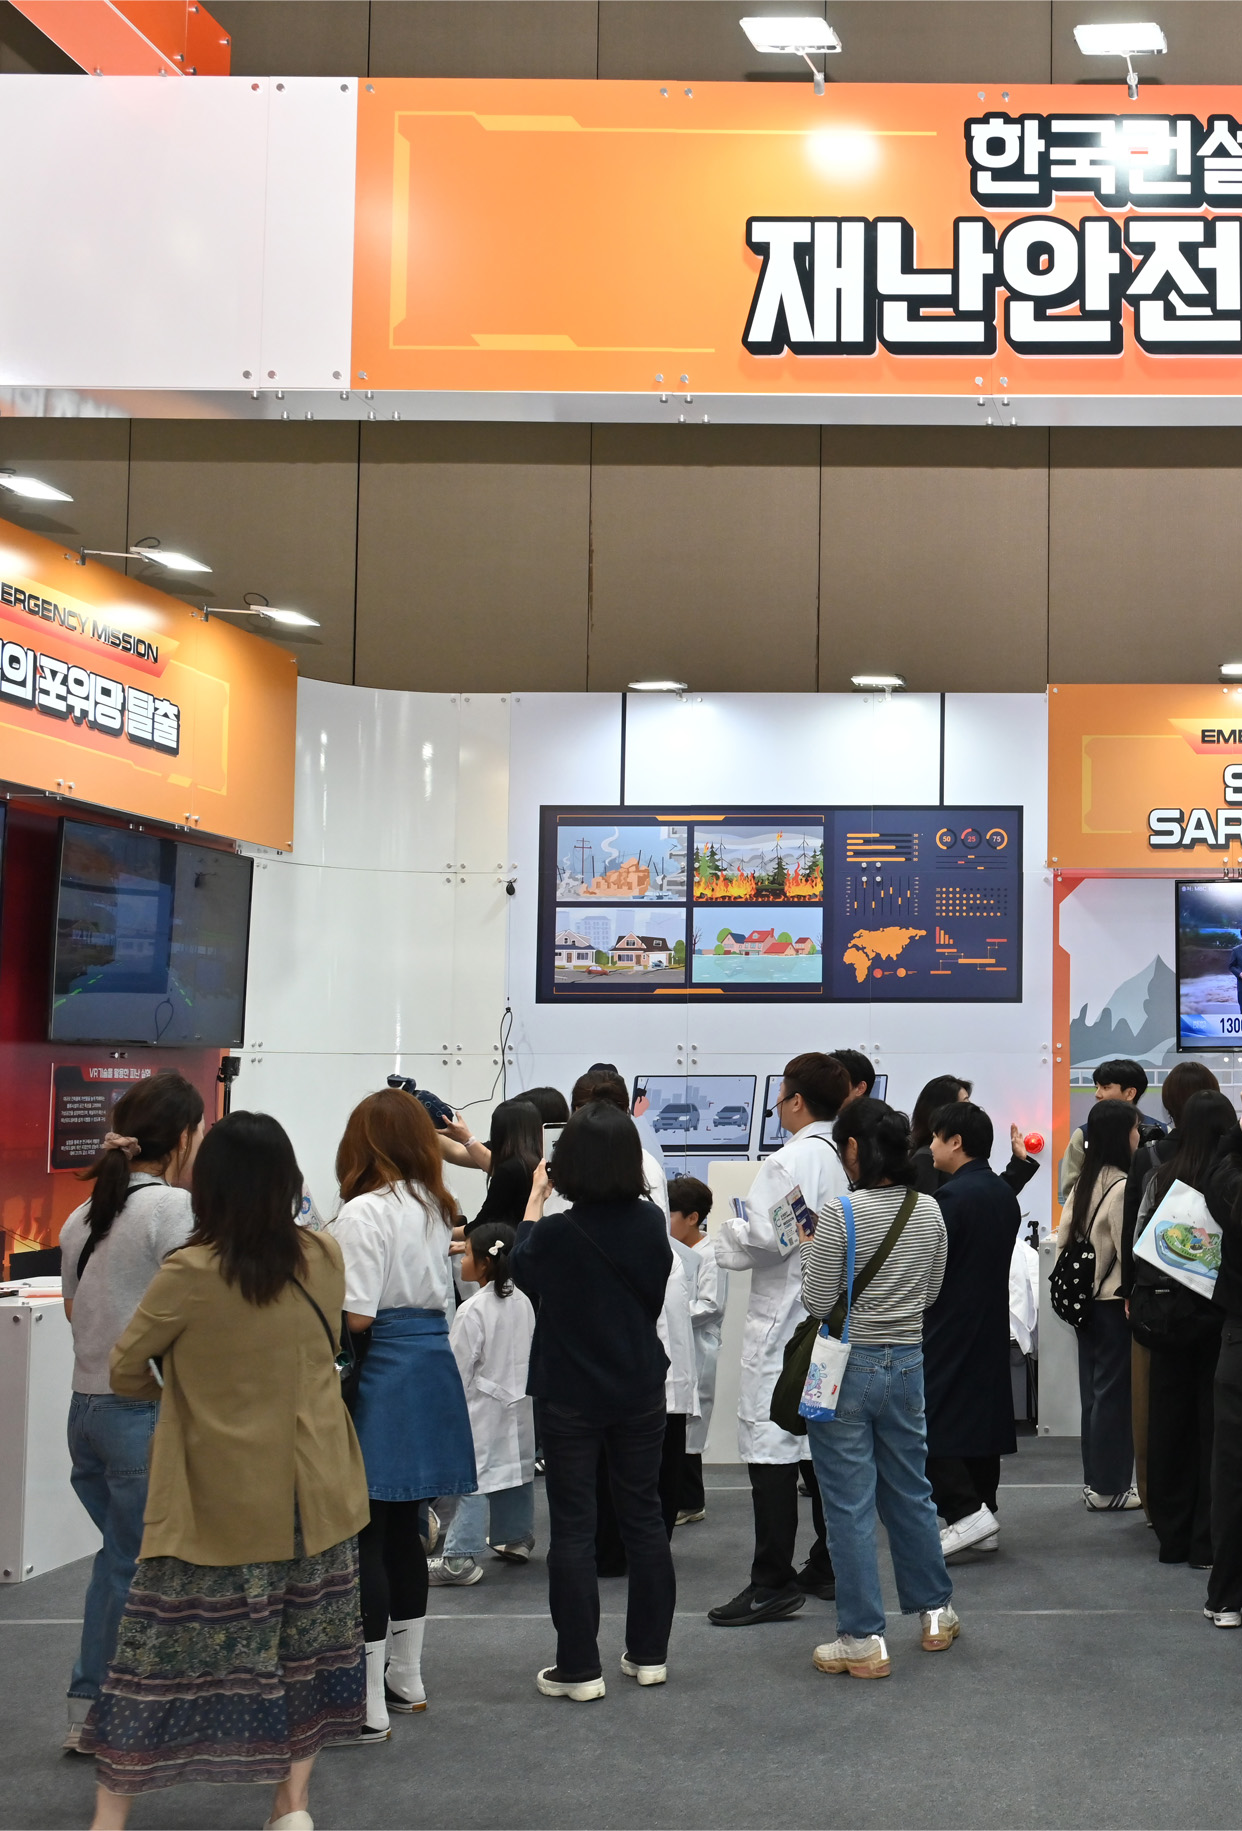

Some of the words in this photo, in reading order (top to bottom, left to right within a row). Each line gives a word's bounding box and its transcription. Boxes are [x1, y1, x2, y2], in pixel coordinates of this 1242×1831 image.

[746, 219, 1242, 345] 재난안전
[1, 581, 90, 635] ERGENCY
[91, 622, 159, 664] MISSION
[0, 640, 34, 702] 의
[38, 653, 124, 731] 포위망
[127, 685, 179, 751] 탈출
